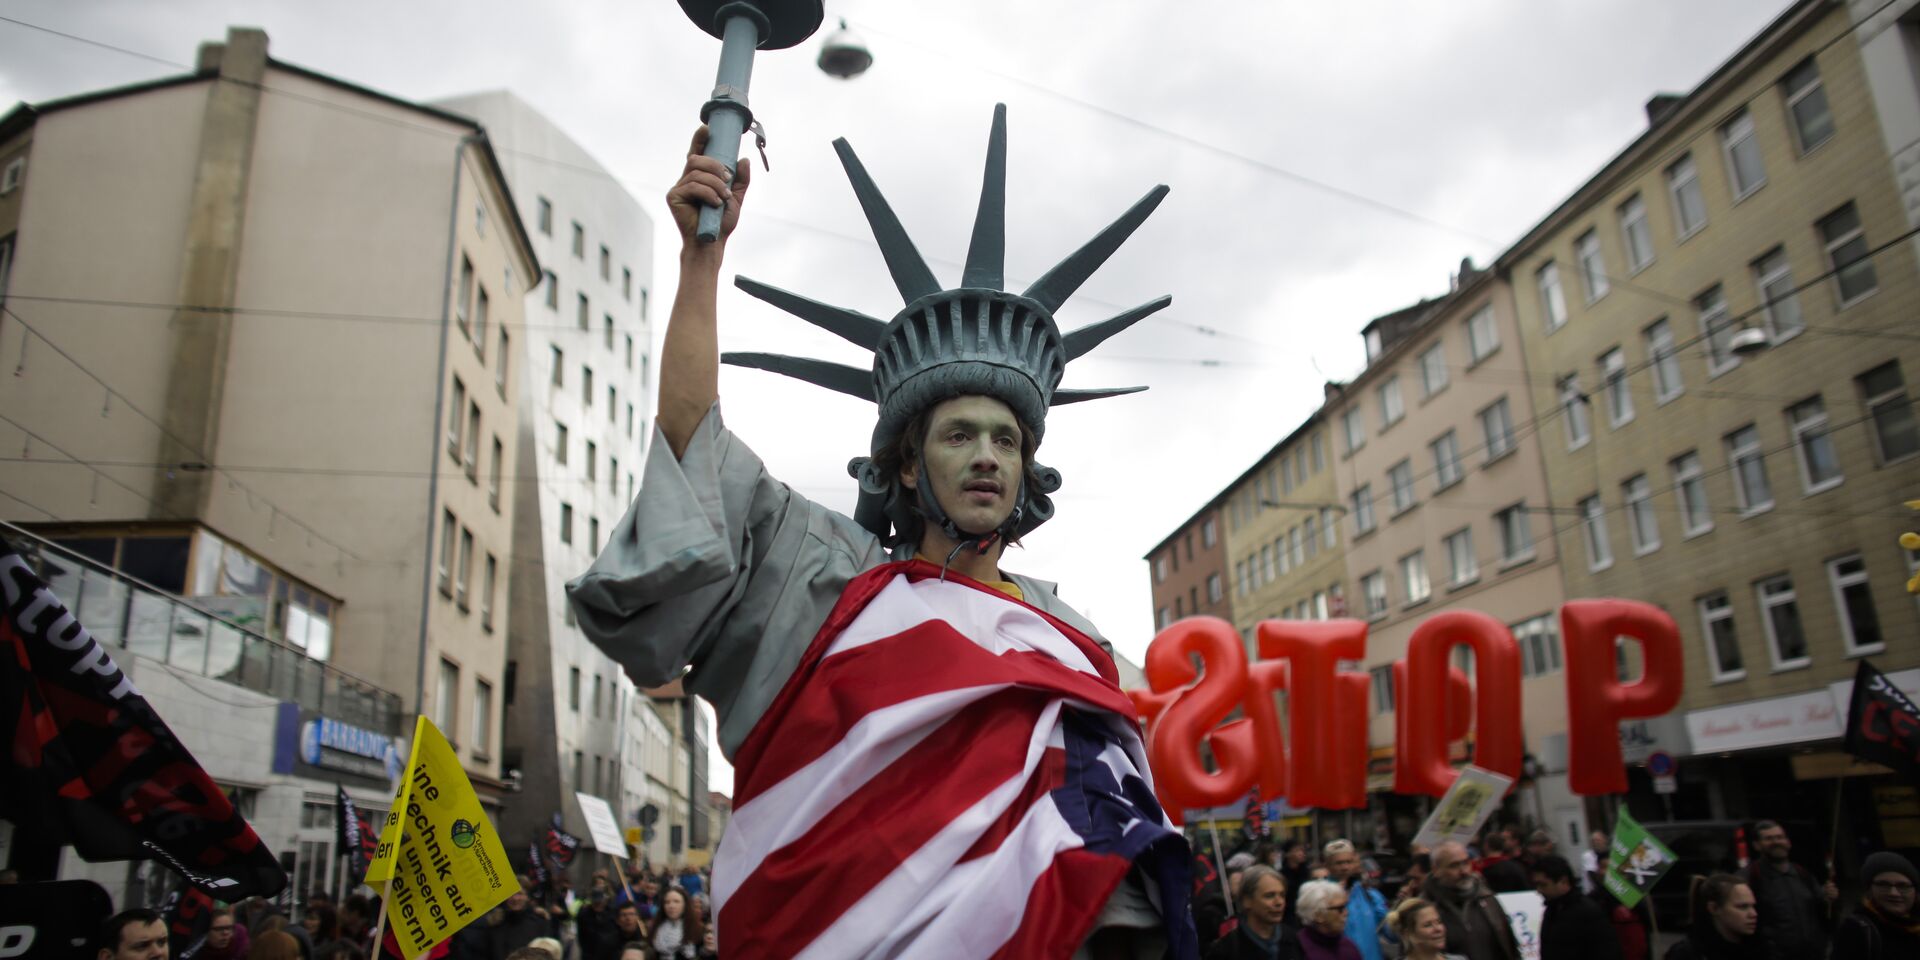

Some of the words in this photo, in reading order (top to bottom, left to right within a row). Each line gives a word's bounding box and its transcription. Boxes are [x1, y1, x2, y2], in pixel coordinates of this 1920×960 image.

[1146, 599, 1683, 812] STOP
[406, 847, 449, 931] unseren
[444, 884, 473, 918] auf
